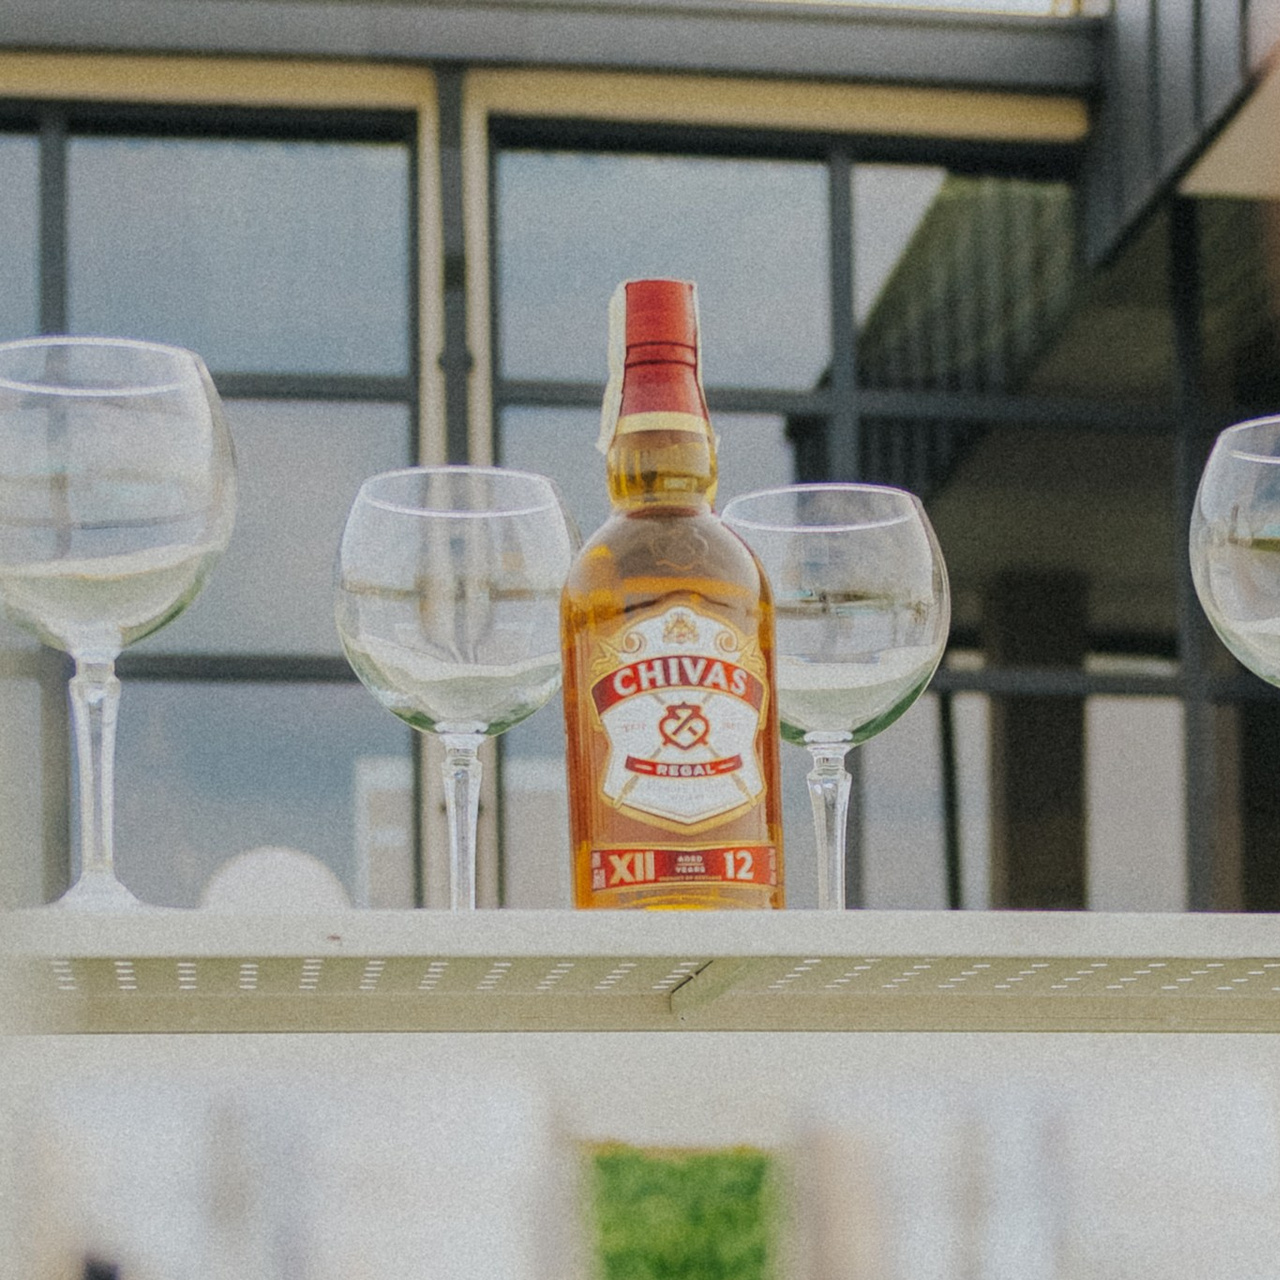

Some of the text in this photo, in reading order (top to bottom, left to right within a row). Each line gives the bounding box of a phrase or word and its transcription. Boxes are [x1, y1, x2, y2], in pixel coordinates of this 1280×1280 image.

[612, 656, 748, 697] CHIVAS
[656, 764, 717, 777] REGAL
[607, 850, 656, 885] XII
[723, 850, 755, 881] 12
